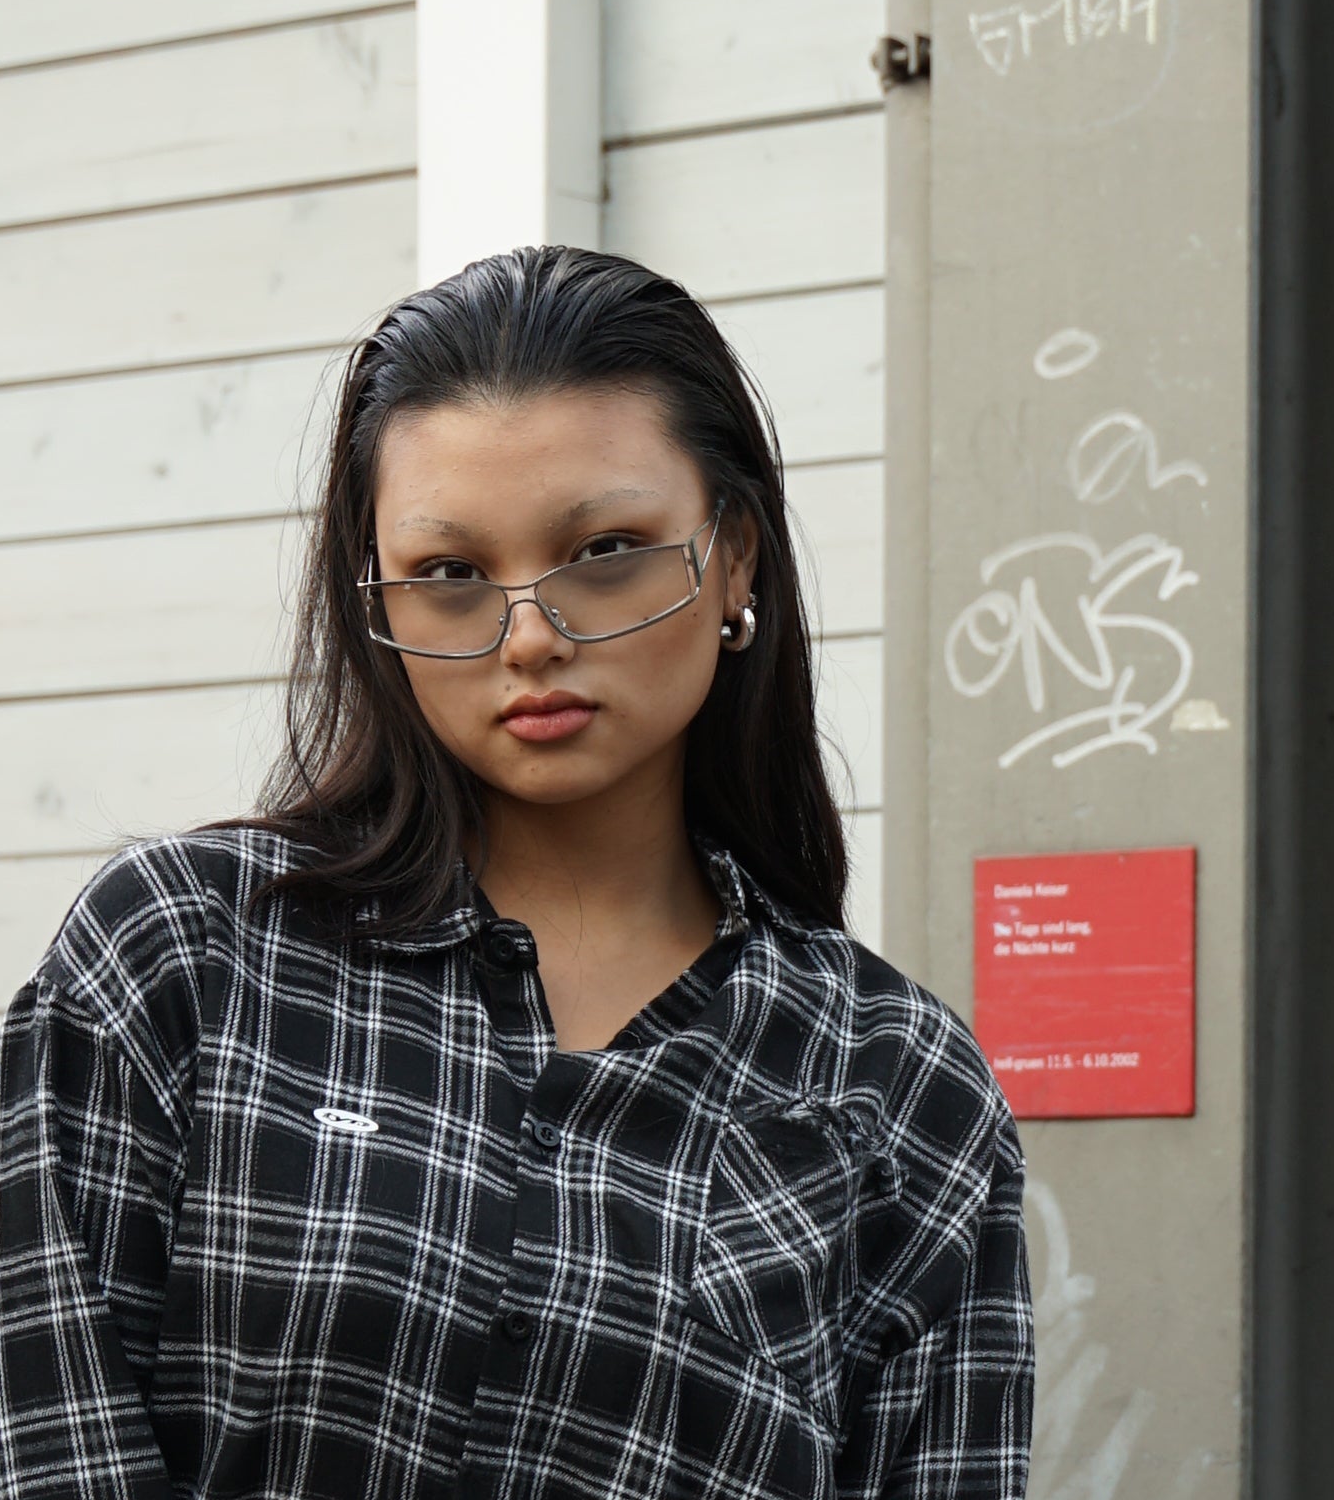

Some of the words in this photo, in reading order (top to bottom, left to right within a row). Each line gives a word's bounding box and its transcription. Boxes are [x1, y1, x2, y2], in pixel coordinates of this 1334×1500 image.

[1014, 921, 1040, 938] Tage
[1041, 920, 1065, 935] sind
[993, 941, 1011, 956] die
[1051, 939, 1076, 955] kurz
